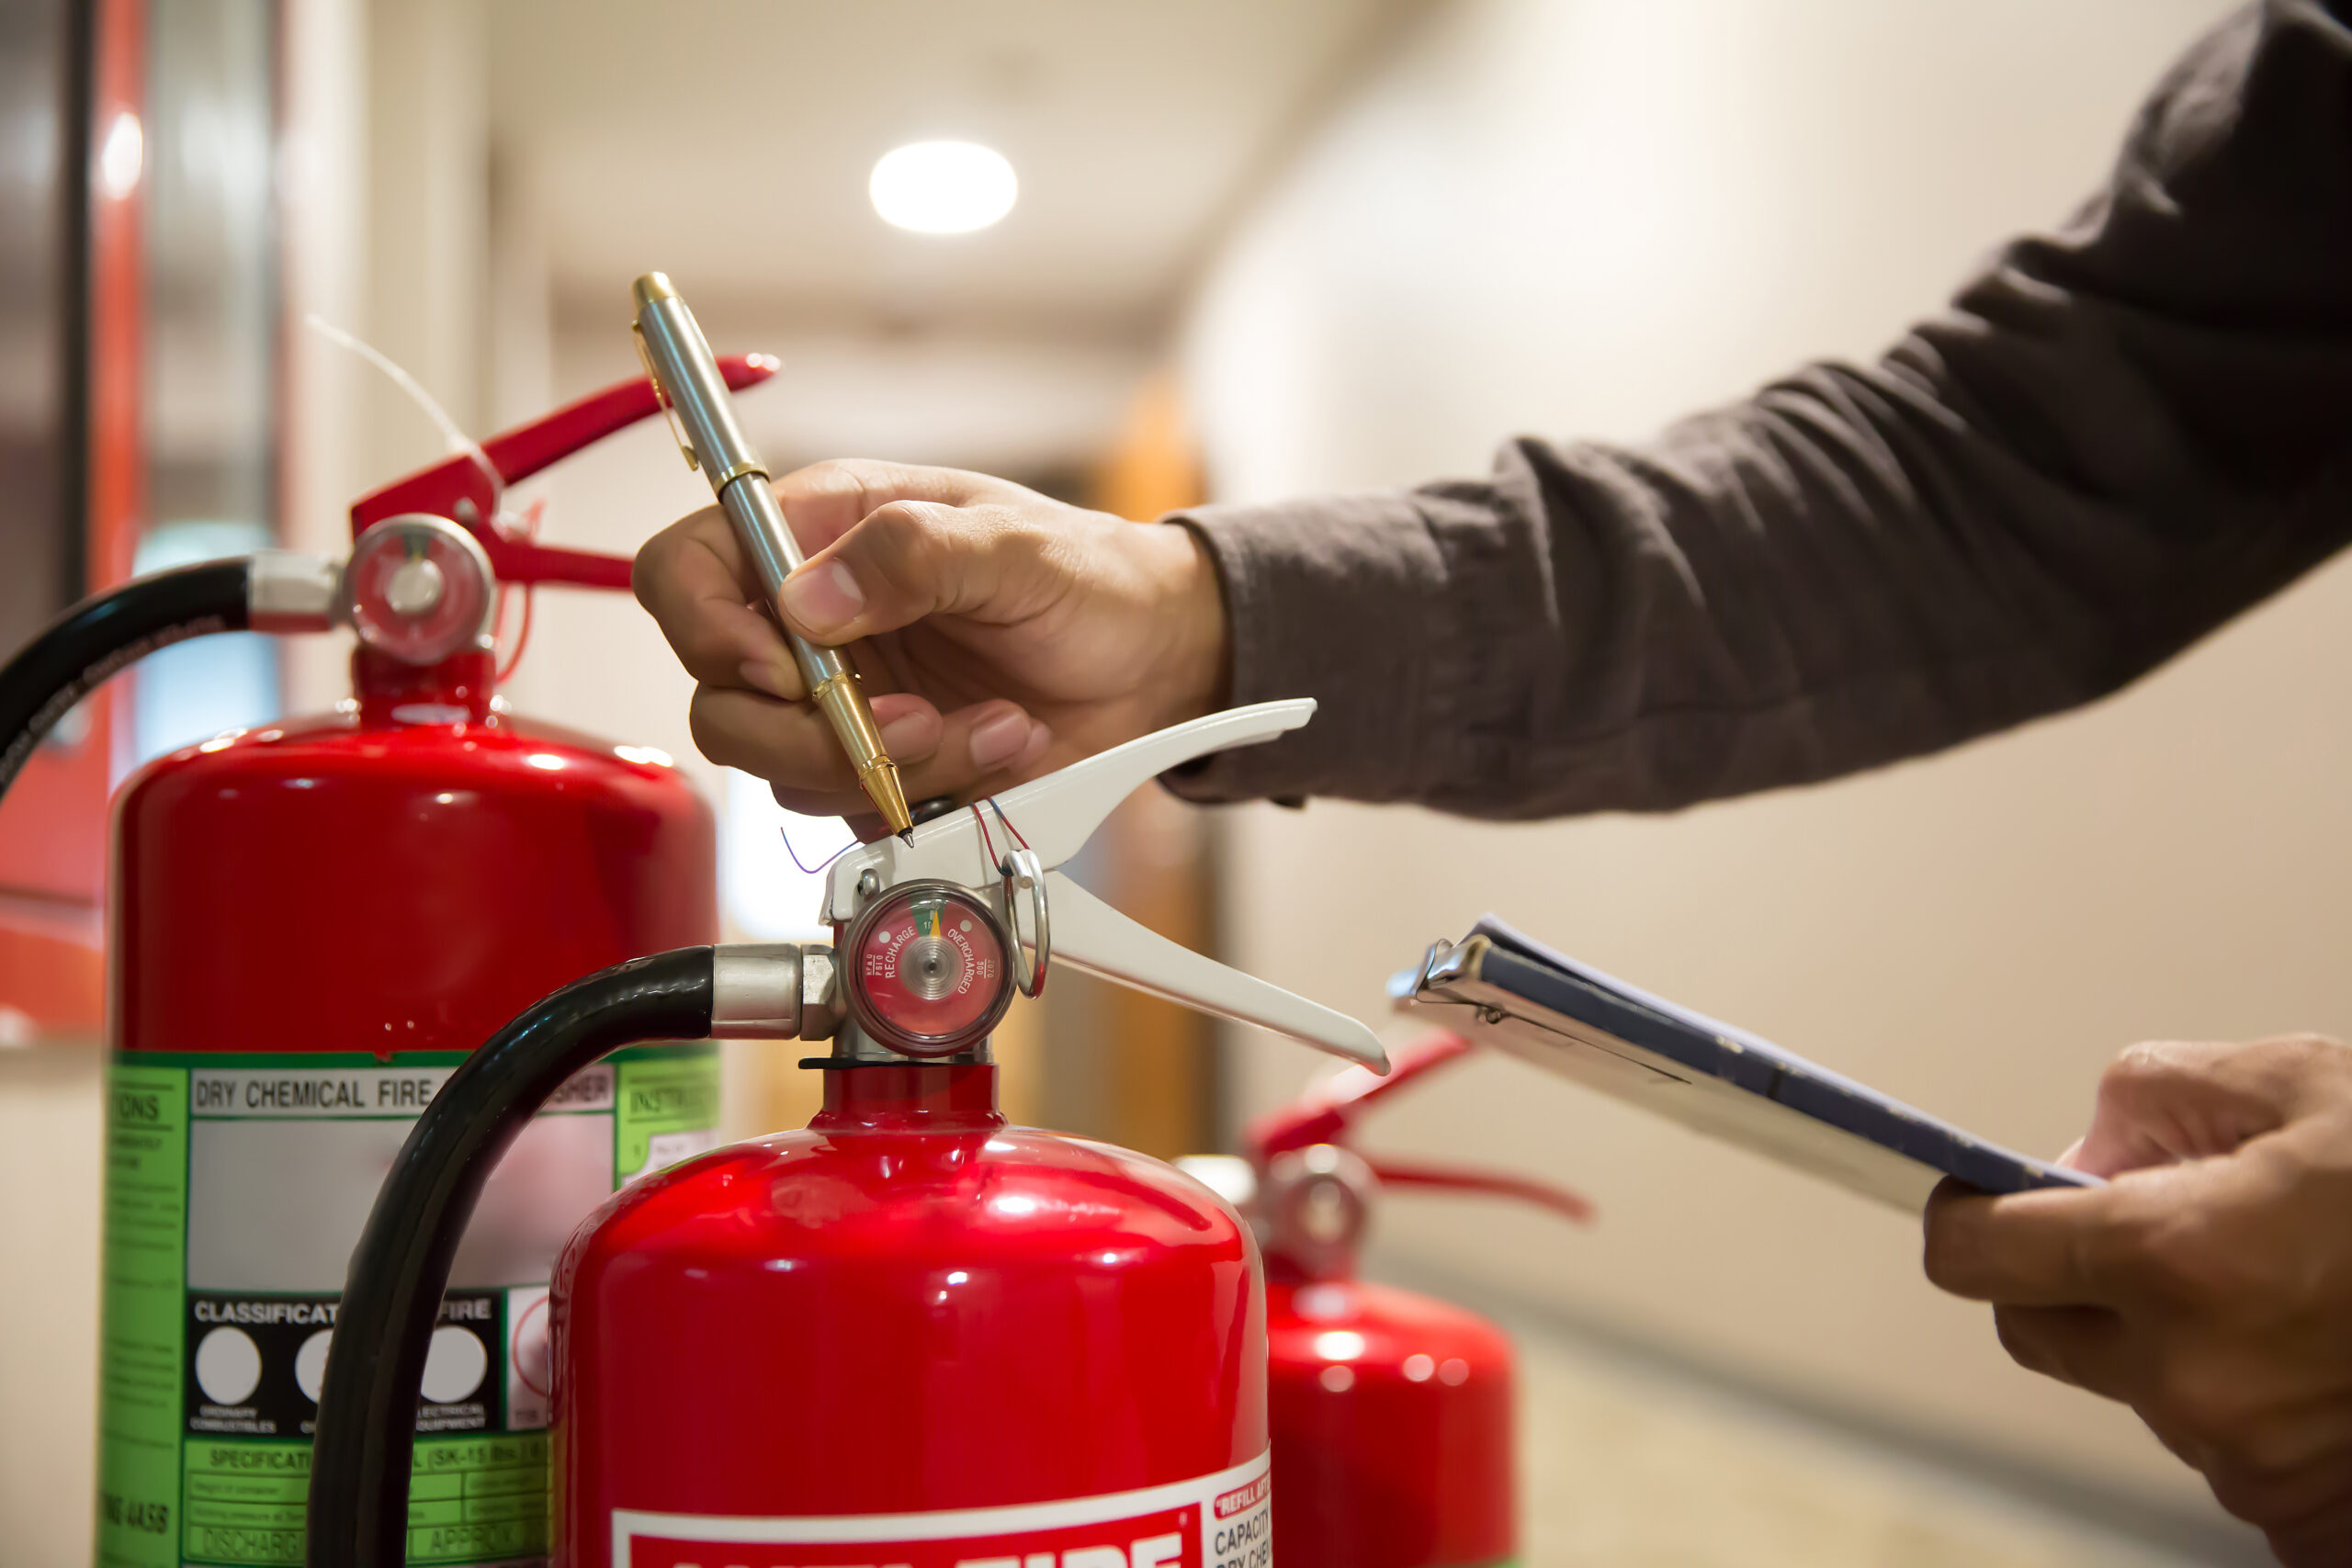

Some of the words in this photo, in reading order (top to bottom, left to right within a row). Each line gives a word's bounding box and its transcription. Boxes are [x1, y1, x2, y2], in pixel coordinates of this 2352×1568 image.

[885, 925, 917, 979] RECHARGE
[947, 928, 976, 995] OVERCHARGED
[976, 961, 984, 976] 300
[197, 1079, 237, 1106] DRY
[245, 1079, 366, 1108] CHEMICAL
[378, 1079, 432, 1106] FIRE
[194, 1300, 339, 1325] CLASSIFICAT
[209, 1449, 311, 1469] SPECIFICATI
[204, 1528, 299, 1560] DISCHARG
